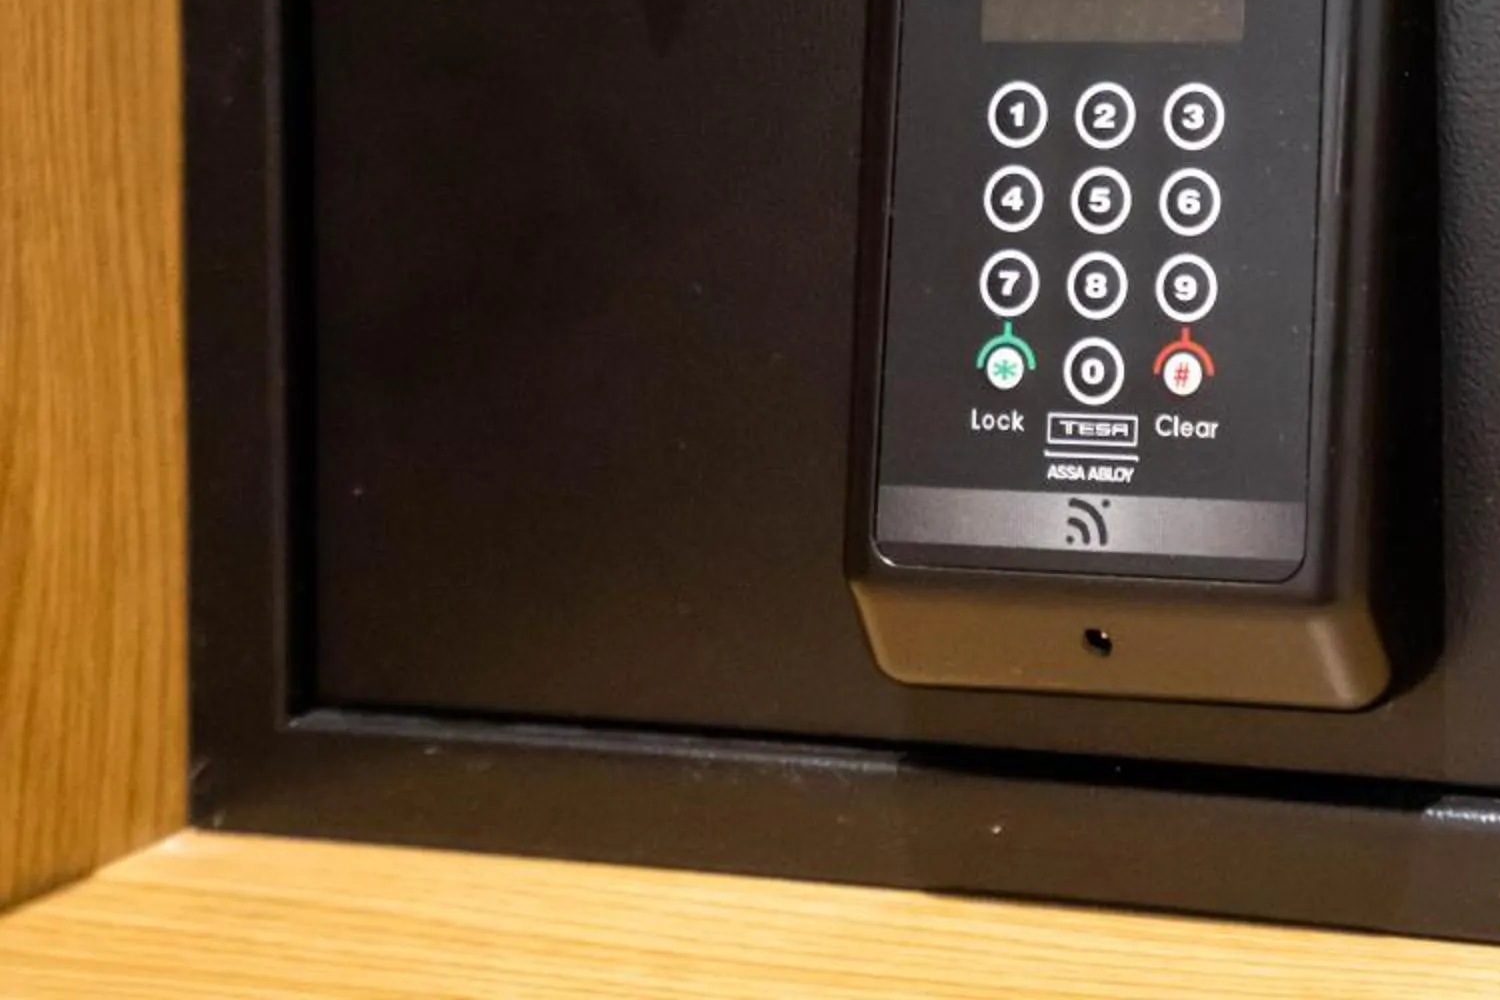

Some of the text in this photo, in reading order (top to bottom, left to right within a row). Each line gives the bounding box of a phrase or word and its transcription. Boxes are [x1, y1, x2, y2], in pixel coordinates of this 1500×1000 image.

[1010, 102, 1024, 127] 1
[1093, 102, 1116, 128] 2
[1181, 103, 1204, 130] 3
[1001, 186, 1024, 212] 4
[1088, 187, 1111, 213] 5
[1177, 188, 1200, 215] 6
[998, 270, 1021, 296] 7
[1085, 272, 1107, 298] 8
[1174, 274, 1197, 301] 9
[1081, 358, 1104, 385] 0
[971, 409, 1025, 432] Lock
[1059, 420, 1129, 437] TESA
[1155, 414, 1219, 439] Clear
[1047, 464, 1135, 483] ASSA ABLOY
